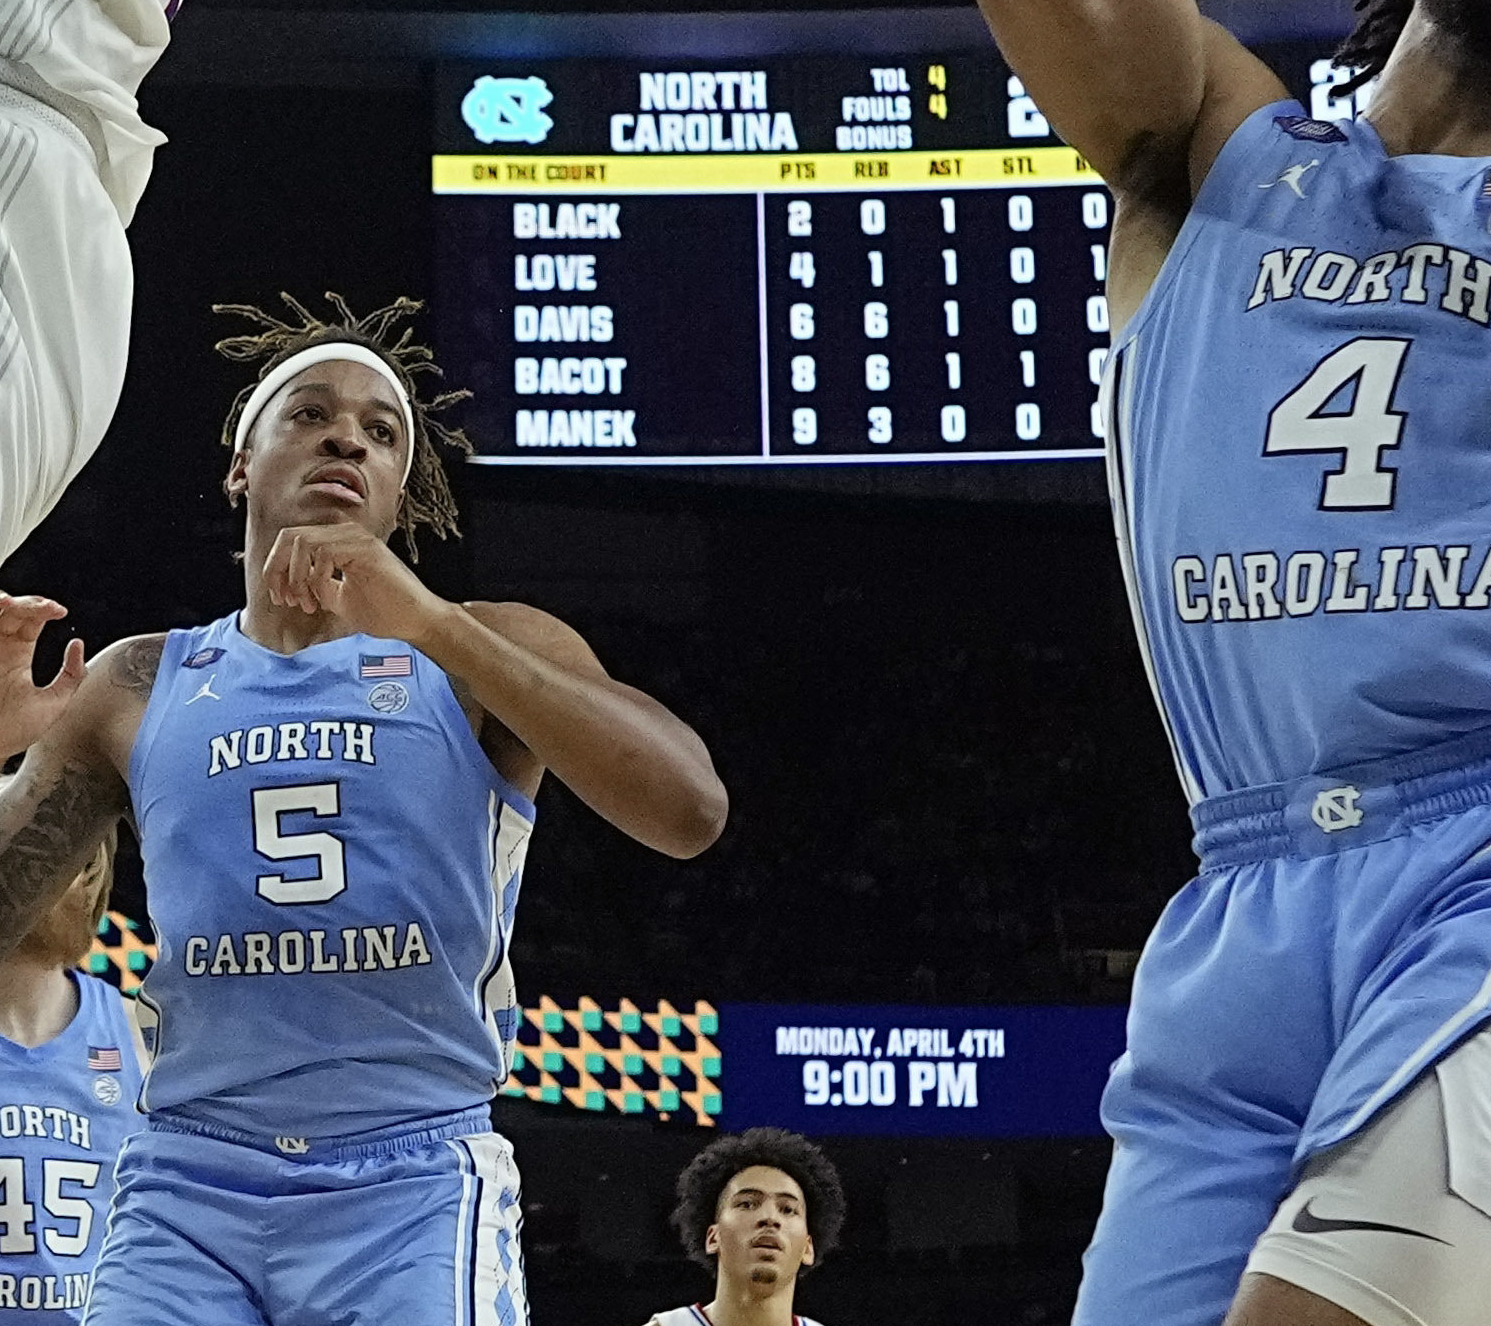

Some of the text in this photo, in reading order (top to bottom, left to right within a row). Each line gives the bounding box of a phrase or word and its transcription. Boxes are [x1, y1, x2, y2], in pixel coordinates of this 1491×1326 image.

[639, 71, 767, 111] NORTH
[870, 64, 947, 93] TOL 4
[842, 93, 948, 122] FOULS 4
[610, 112, 798, 152] CAROLINA
[835, 125, 913, 151] BONUS
[507, 163, 536, 181] THE
[546, 163, 608, 182] COURT
[780, 162, 815, 179] PTS
[929, 158, 962, 176] AST
[1003, 157, 1036, 174] STL
[513, 192, 1108, 239] BLACK 2 0 1 0 0
[514, 244, 1106, 292] LOVE 4 1 1 0 1
[514, 304, 614, 342] DAVIS
[789, 302, 815, 340] 6
[863, 301, 889, 339] 6
[943, 299, 960, 338] 1
[1011, 297, 1037, 335] 0
[514, 356, 628, 395] BACOT
[790, 354, 816, 392] 8
[864, 354, 891, 391] 6
[944, 351, 961, 390] 1
[1019, 350, 1036, 388] 1
[515, 402, 1041, 448] MANEK 9 3 0 0
[1261, 336, 1413, 511] 4
[207, 720, 376, 778] NORTH
[250, 781, 347, 906] 5
[184, 922, 433, 977] CAROLINA
[776, 1028, 1005, 1059] MONDAY, APRIL 4TH
[802, 1061, 978, 1107] 9:00 PM
